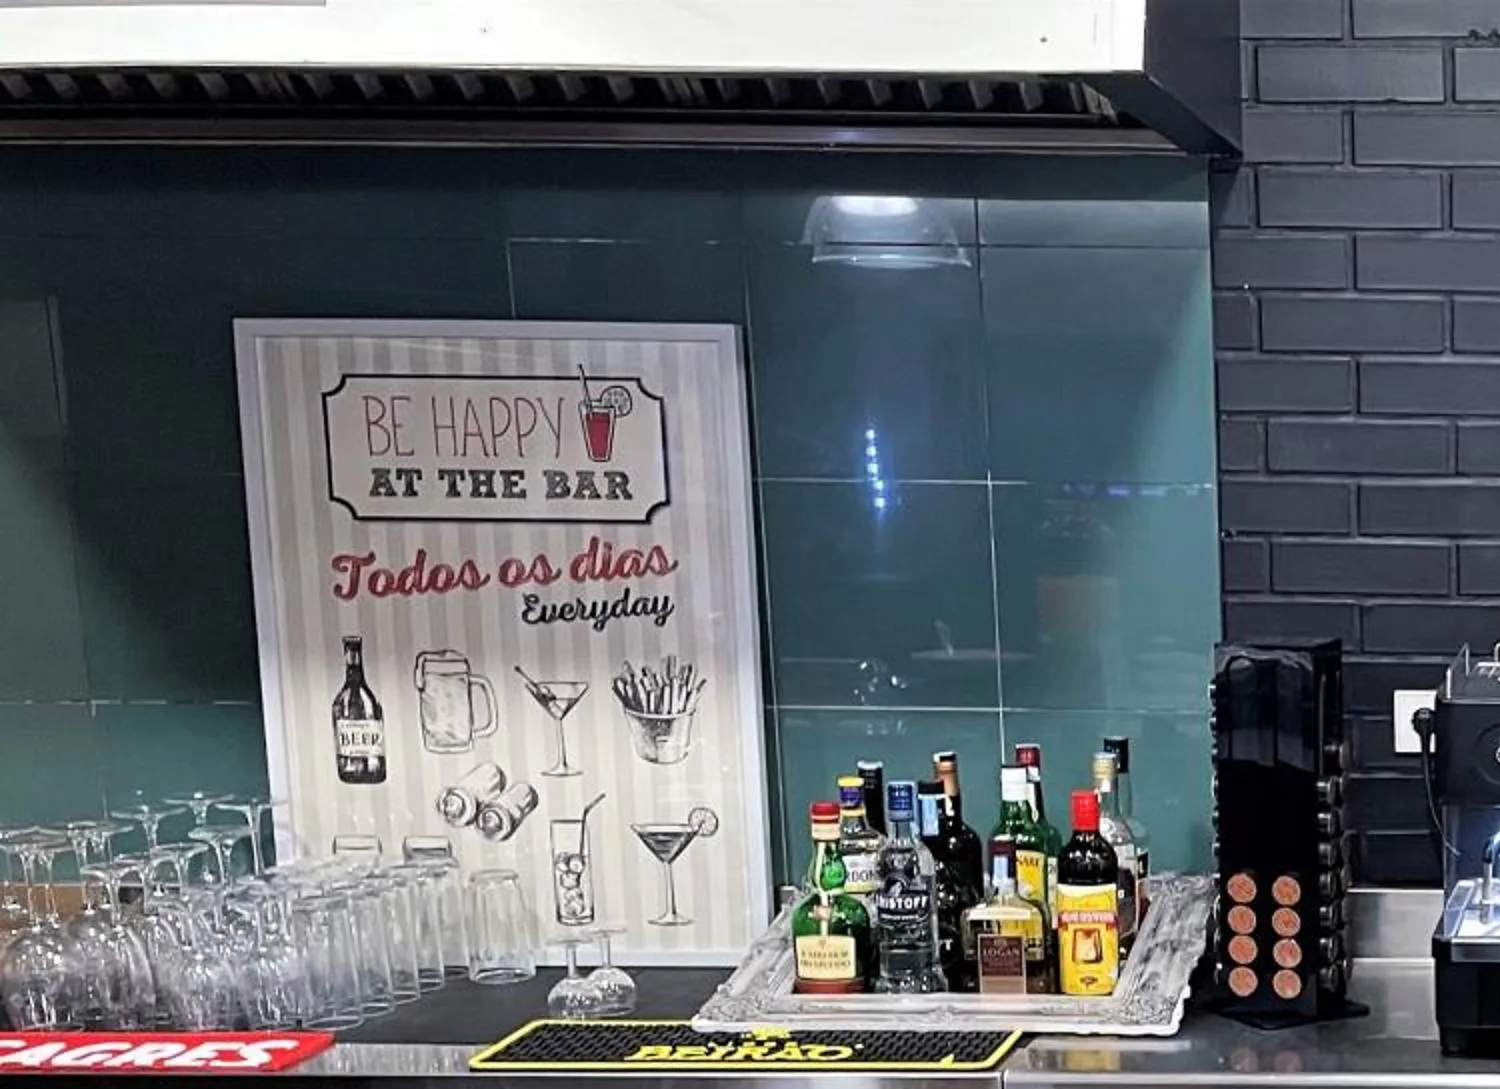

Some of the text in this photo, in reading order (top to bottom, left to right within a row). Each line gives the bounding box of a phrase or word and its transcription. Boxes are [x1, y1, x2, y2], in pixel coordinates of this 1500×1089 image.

[363, 395, 566, 460] BE HAPPY
[368, 468, 633, 501] AT THE BAR
[331, 535, 679, 600] Todos os dias
[521, 587, 675, 633] Everyday
[340, 731, 380, 746] BEER
